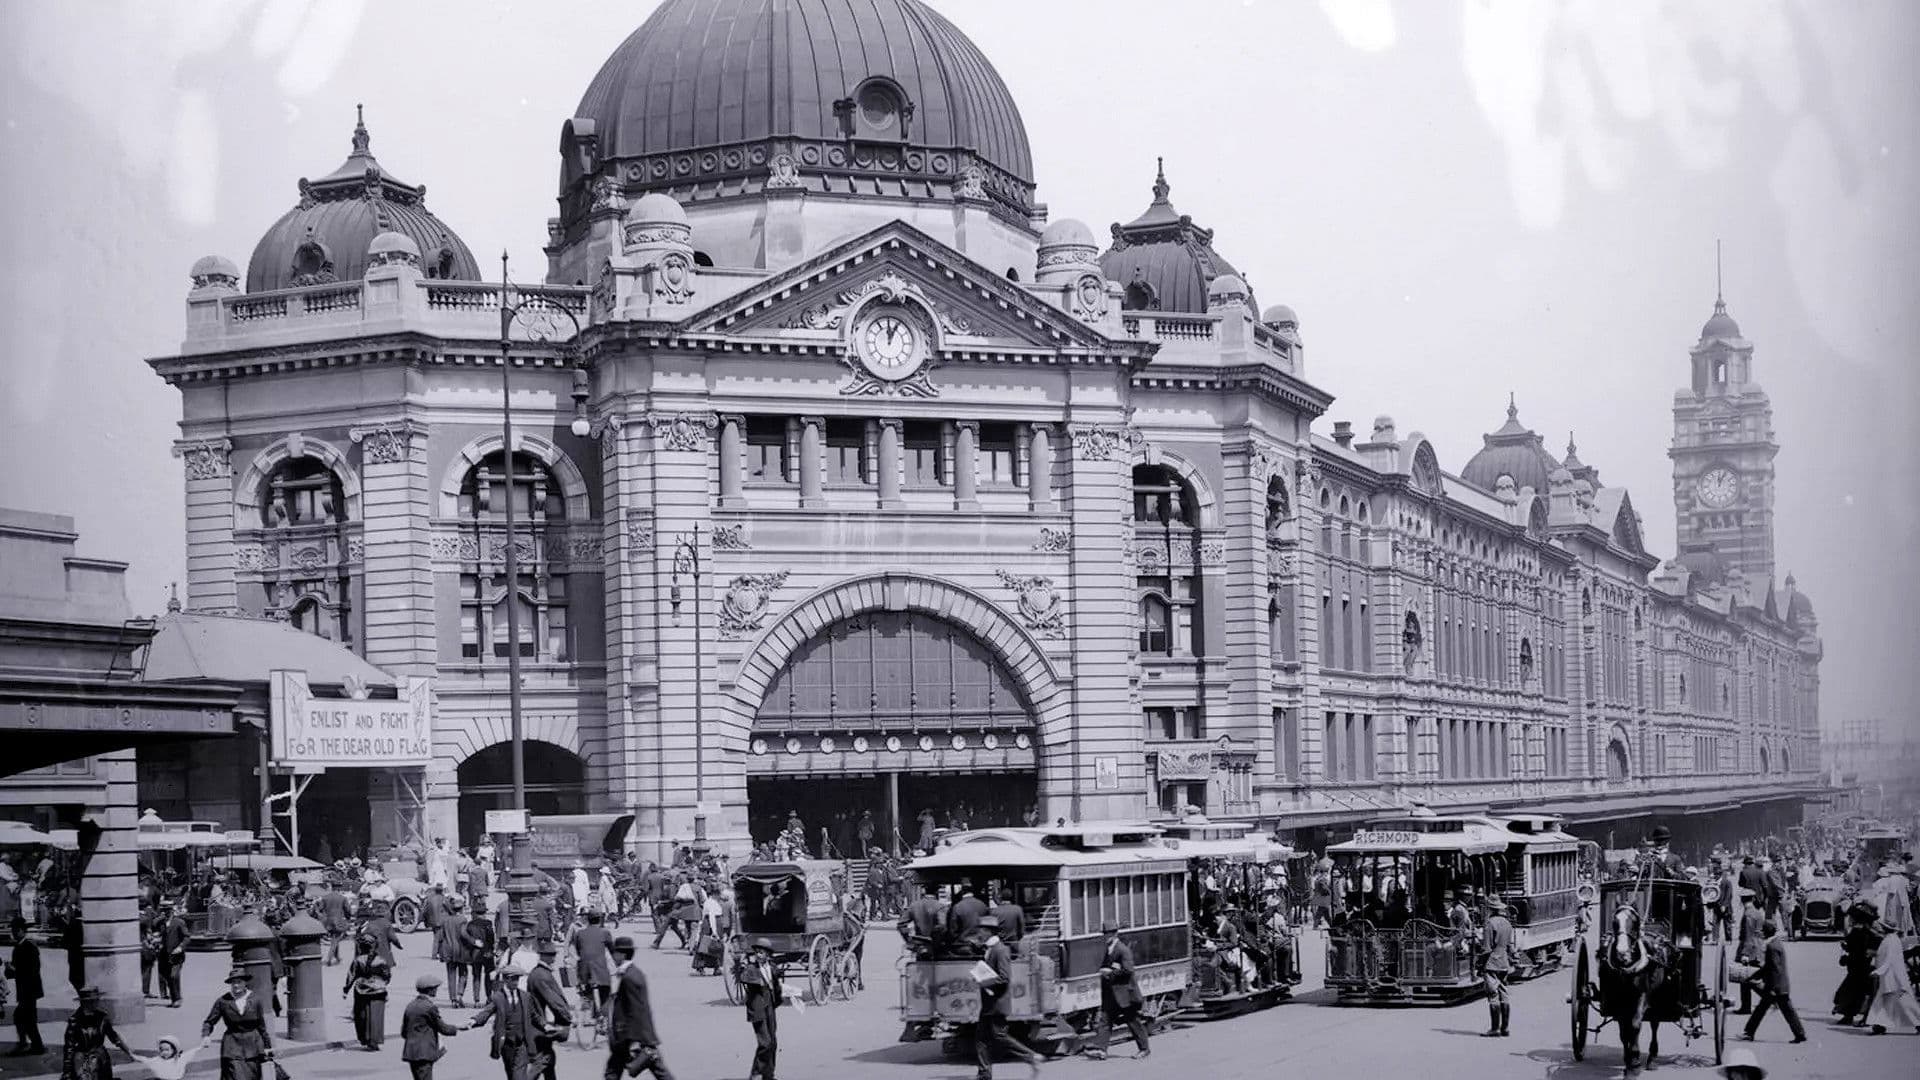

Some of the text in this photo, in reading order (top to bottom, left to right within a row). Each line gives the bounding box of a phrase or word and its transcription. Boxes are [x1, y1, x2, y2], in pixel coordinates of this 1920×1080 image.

[311, 711, 408, 728] ENLIST AND FIGHT
[289, 738, 428, 755] FOR THE DEAR OLD FLAG
[1354, 831, 1419, 843] RICHMOND
